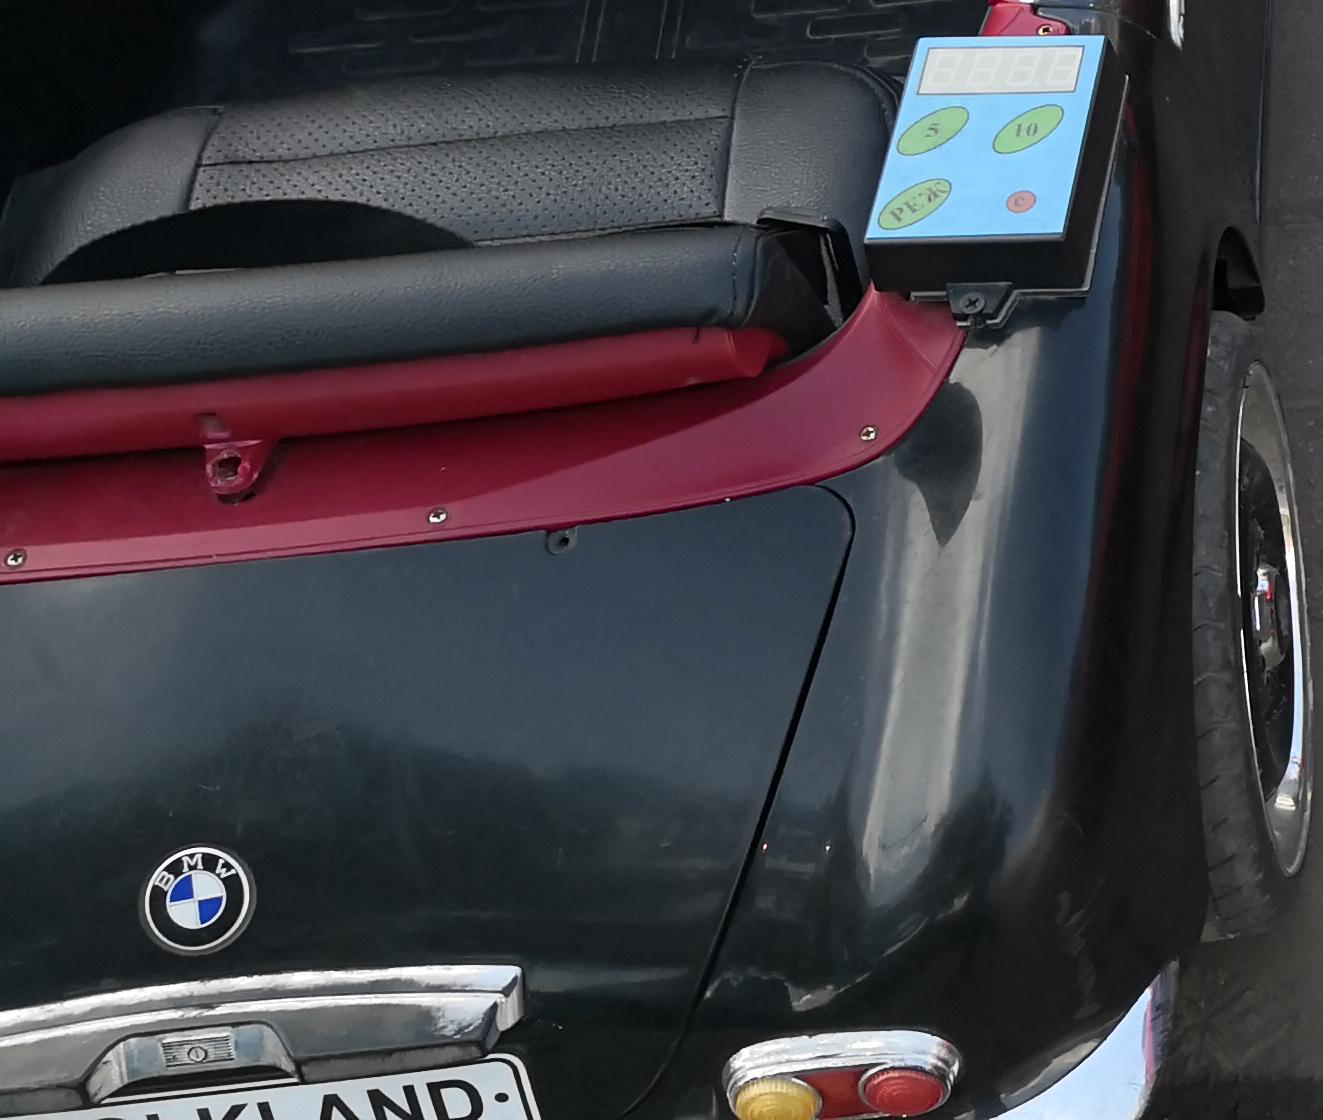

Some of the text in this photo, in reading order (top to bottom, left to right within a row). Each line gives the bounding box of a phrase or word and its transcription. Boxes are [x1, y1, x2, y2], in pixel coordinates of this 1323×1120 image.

[924, 122, 940, 138] 5
[1014, 122, 1039, 138] 10
[889, 181, 948, 223] РЕЖ
[153, 852, 237, 892] BMW
